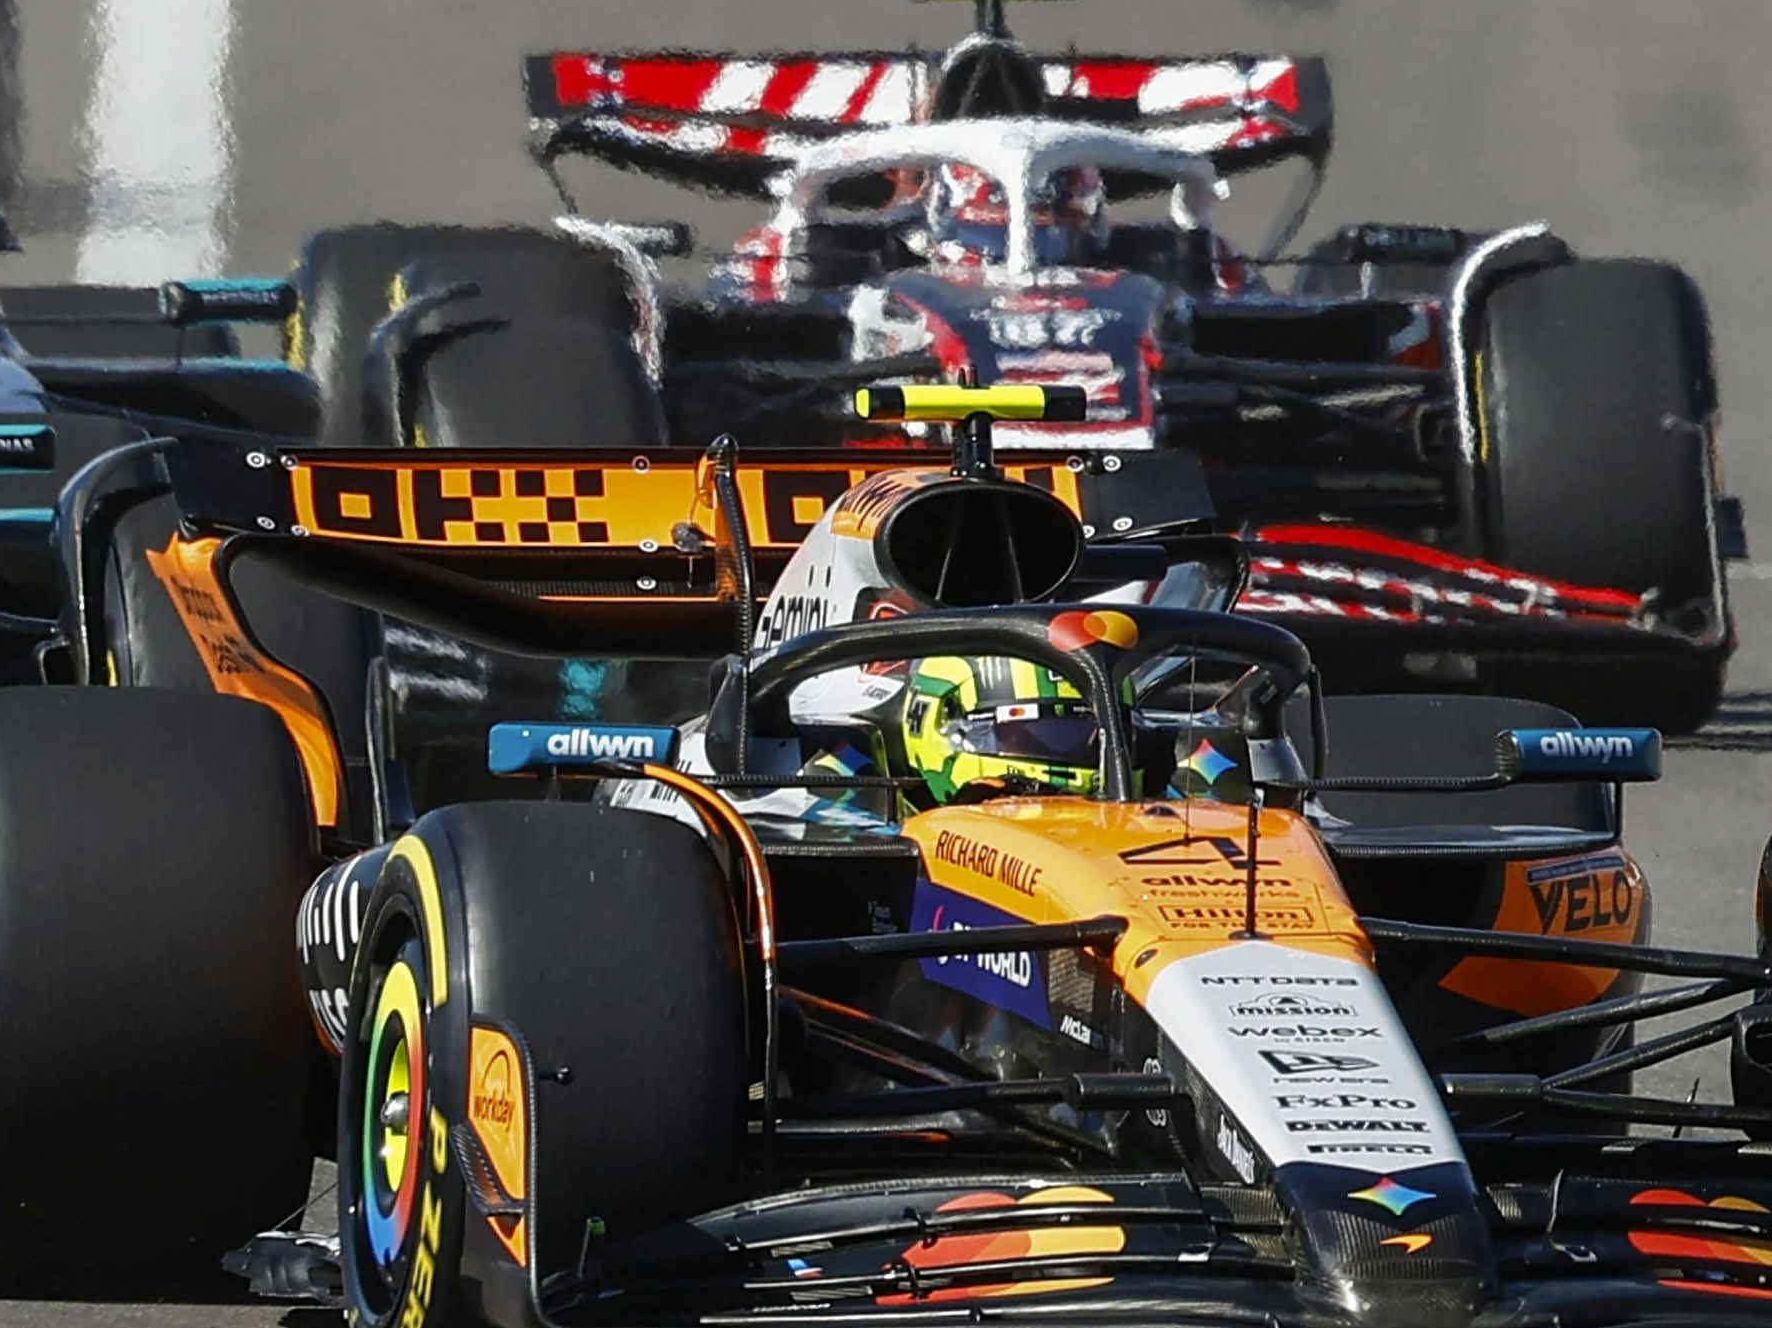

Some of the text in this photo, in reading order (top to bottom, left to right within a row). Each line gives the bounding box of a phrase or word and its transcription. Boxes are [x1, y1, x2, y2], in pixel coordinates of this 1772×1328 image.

[547, 729, 654, 758] allwyn
[1539, 731, 1633, 764] allwyn
[935, 829, 1043, 898] RICHARD MILLE
[1529, 869, 1632, 936] VELO
[1200, 976, 1265, 986] NTT
[1236, 1005, 1351, 1016] mission
[1228, 1024, 1383, 1037] webex
[472, 1087, 517, 1125] workday
[1274, 1094, 1418, 1110] FxPro
[429, 1105, 448, 1175] P
